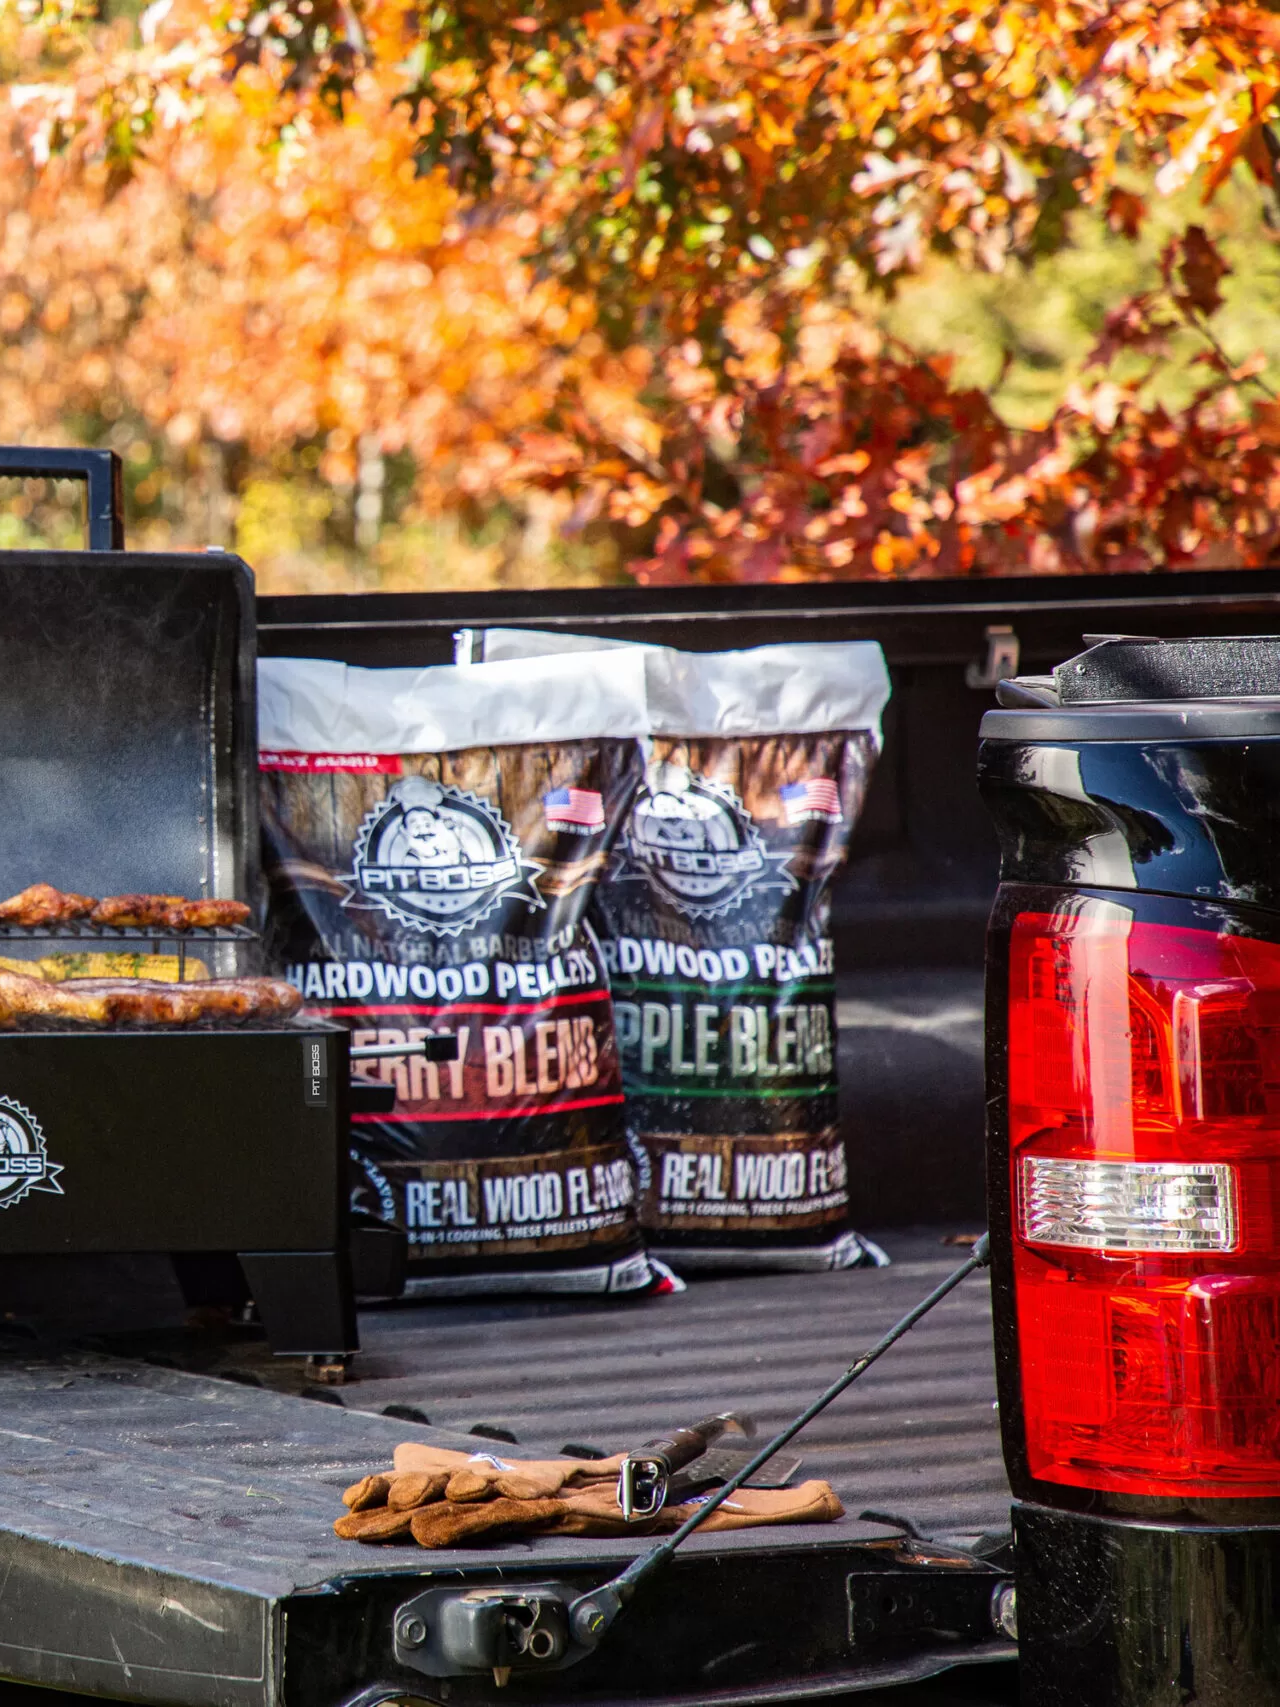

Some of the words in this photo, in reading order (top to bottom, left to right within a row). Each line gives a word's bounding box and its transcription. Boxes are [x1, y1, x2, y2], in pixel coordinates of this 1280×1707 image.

[361, 868, 417, 890] PIT
[419, 858, 517, 891] BOSS
[672, 849, 763, 875] BOSS
[352, 936, 468, 966] NATURAL
[470, 924, 574, 961] BARBECU
[601, 936, 750, 982] RDWOOD
[285, 961, 490, 1000] HARDWOOD
[350, 1026, 470, 1100] ERRY
[483, 1016, 599, 1097] BLEND
[613, 1001, 719, 1077] PPLE
[730, 1004, 833, 1078] BLEND
[312, 1044, 320, 1076] BOSS
[312, 1079, 320, 1096] PIT
[661, 1151, 727, 1200] REAL
[735, 1150, 806, 1200] WOOD
[406, 1179, 477, 1227] REAL
[483, 1172, 563, 1225] WOOD
[506, 1223, 543, 1239] THESE
[544, 1218, 589, 1237] PELLETS
